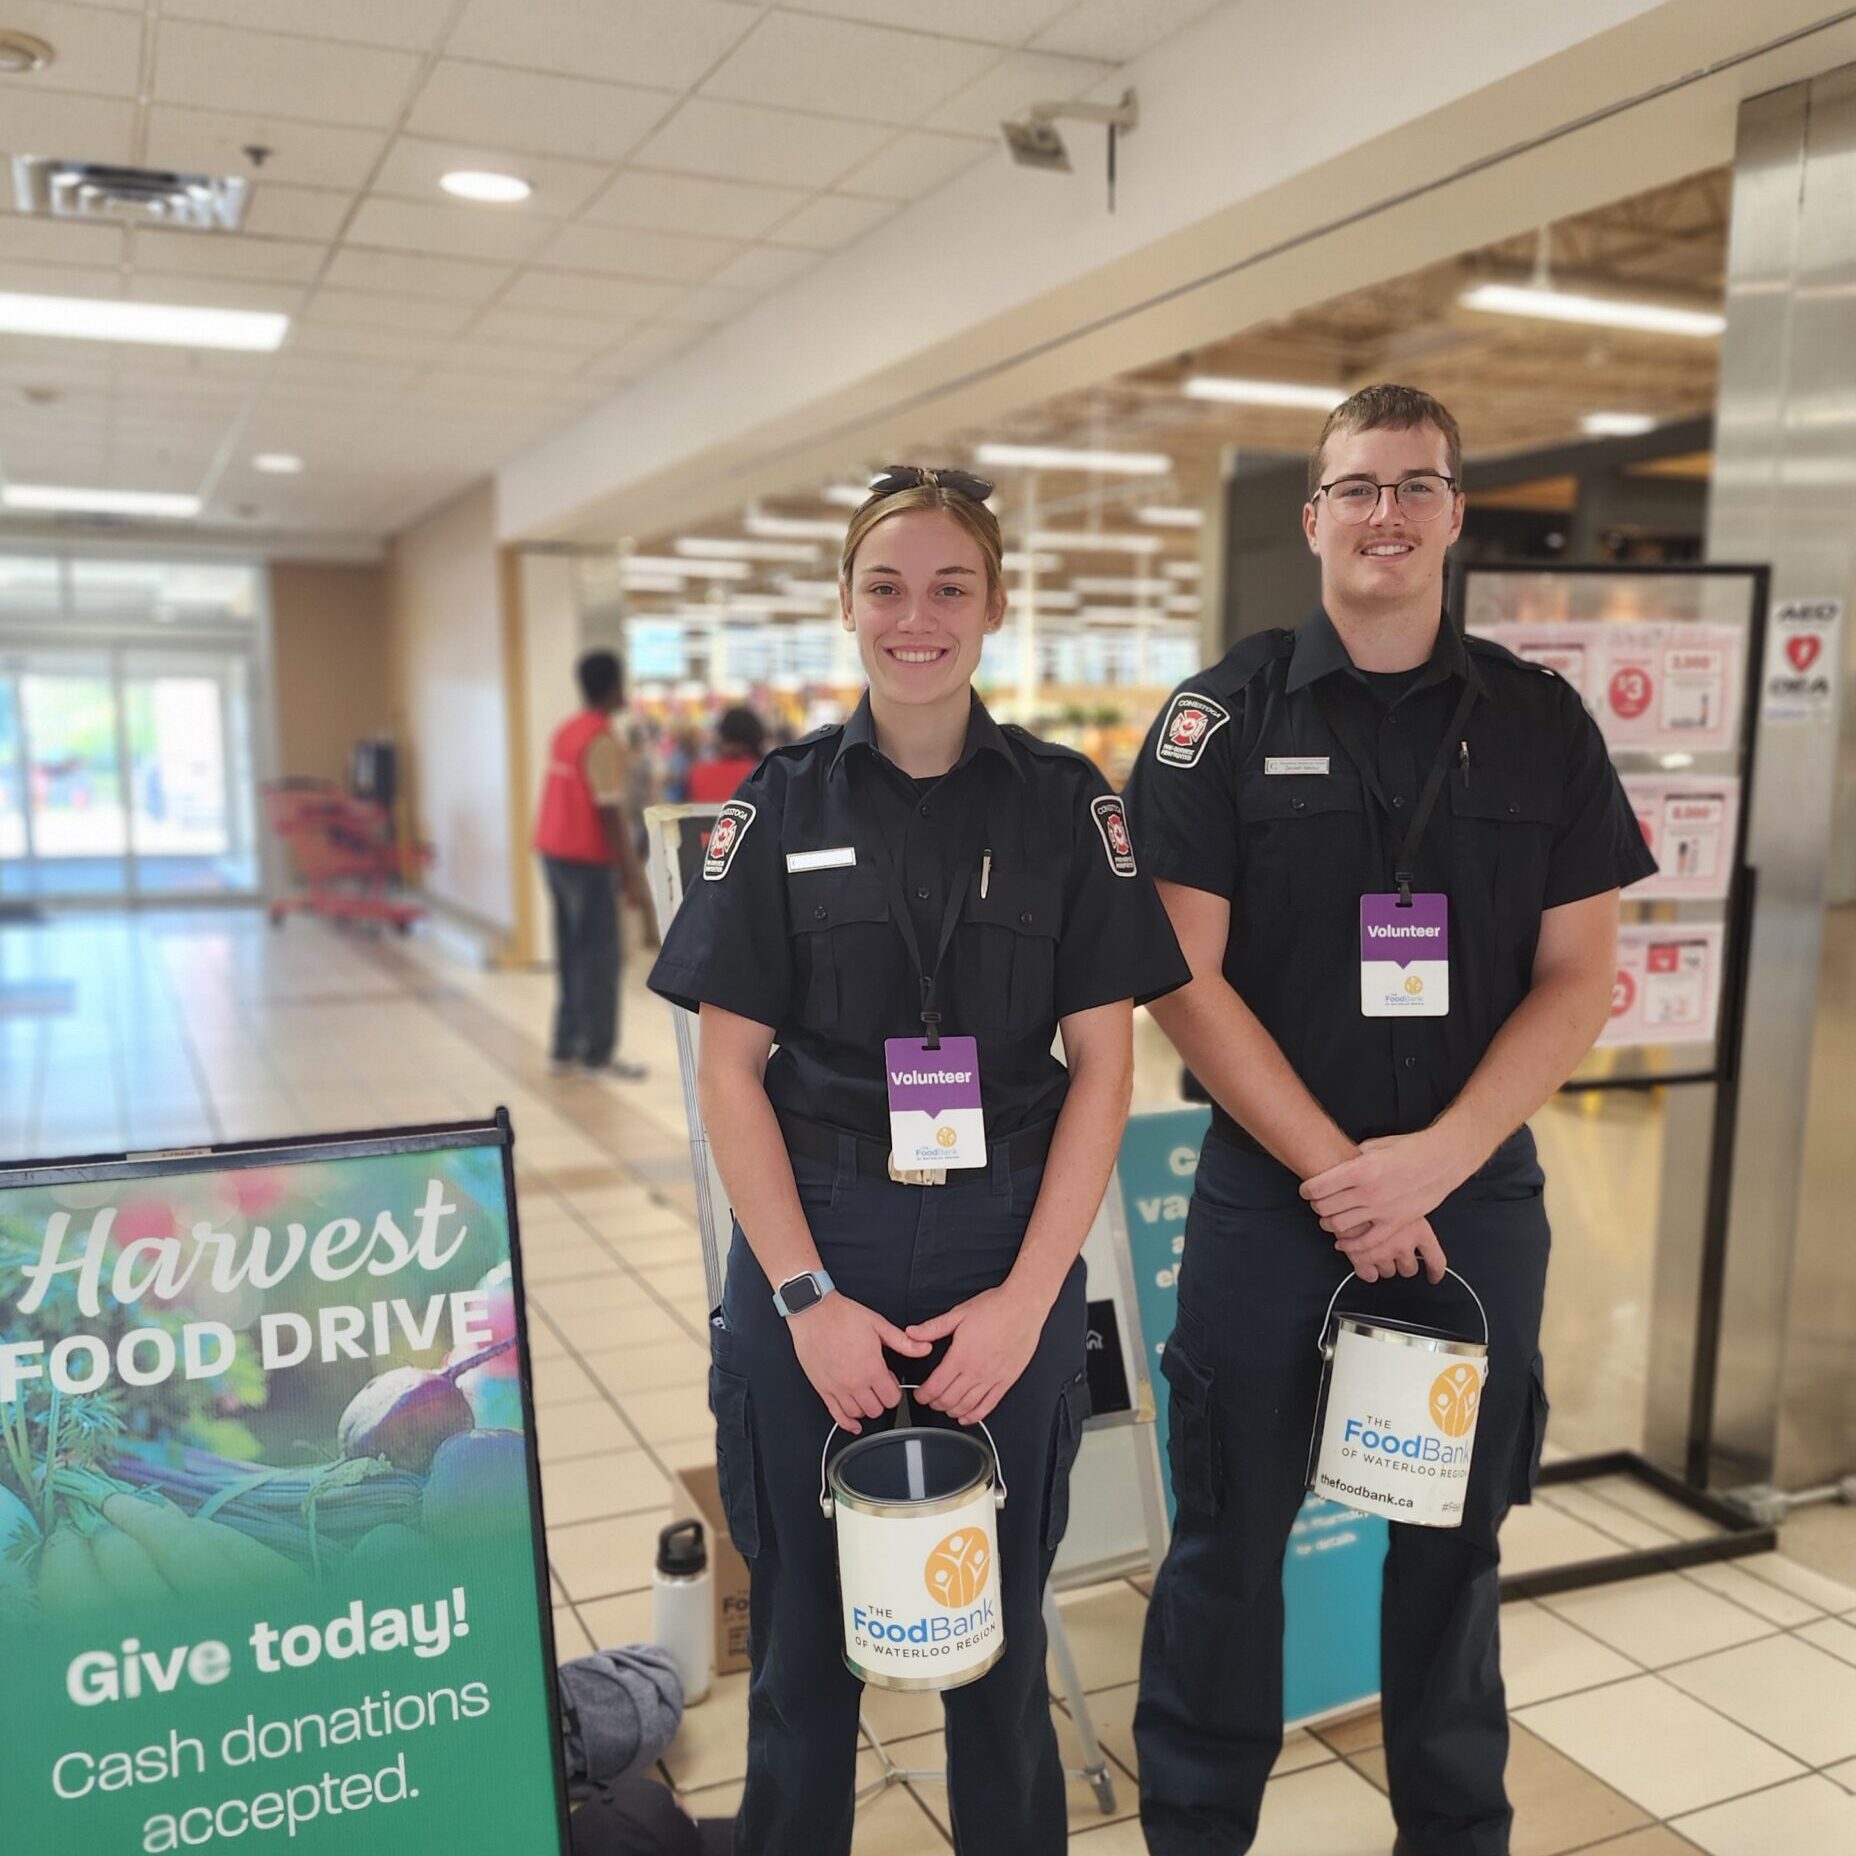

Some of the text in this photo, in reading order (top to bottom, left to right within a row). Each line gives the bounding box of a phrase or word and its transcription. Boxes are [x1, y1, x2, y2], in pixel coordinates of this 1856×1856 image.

[1178, 700, 1222, 718] CONESTOGA
[1367, 924, 1441, 938] Volunteer
[890, 1070, 972, 1086] Volunteer
[17, 1179, 468, 1318] Harvest
[0, 1290, 494, 1402] FOOD DRIVE
[1366, 1415, 1392, 1430] THE
[1344, 1419, 1469, 1464] FoodBank
[1341, 1447, 1358, 1459] OF
[1363, 1453, 1436, 1477] WATERLOO
[1320, 1473, 1414, 1508] thefoodbank.ca
[853, 1598, 994, 1643] FoodBank
[868, 1605, 893, 1618] THE
[66, 1587, 470, 1708] Give today!
[855, 1622, 996, 1658] OF WATERLOO REGION
[52, 1680, 490, 1800] Cash donations
[142, 1752, 420, 1854] accepted.
